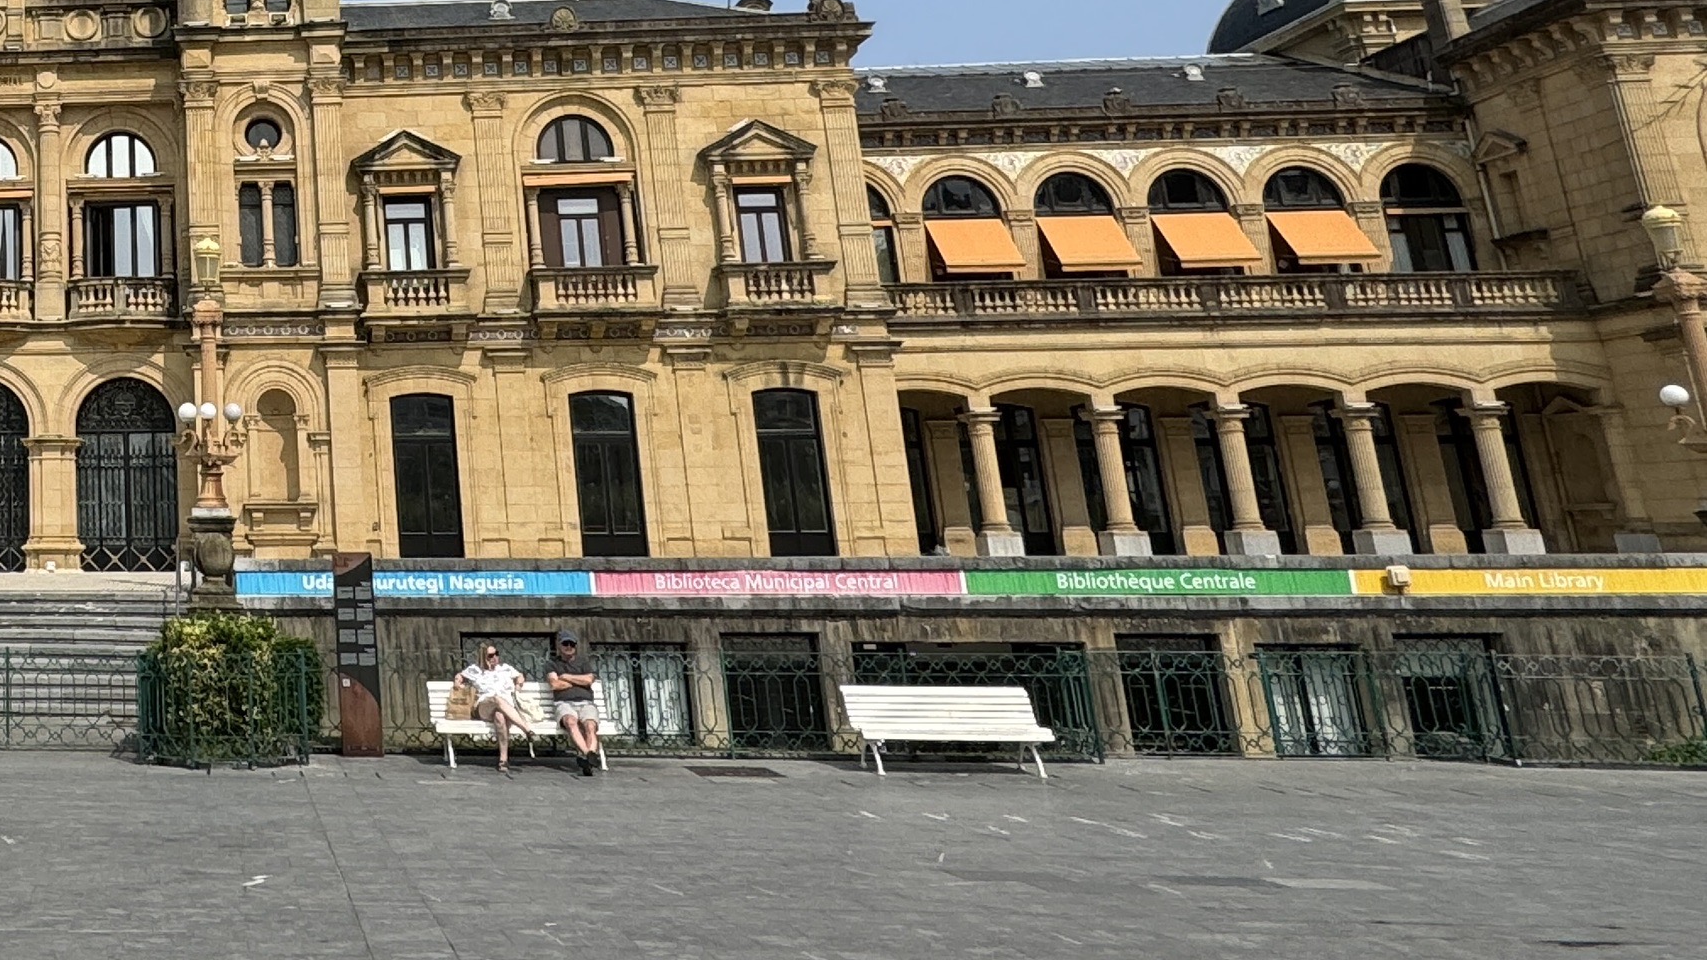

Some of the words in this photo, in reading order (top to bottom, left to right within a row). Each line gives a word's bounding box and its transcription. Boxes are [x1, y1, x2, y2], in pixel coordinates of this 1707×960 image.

[302, 574, 334, 591] Uda
[373, 575, 444, 594] urutegi
[449, 574, 524, 594] Nagusia
[655, 573, 740, 590] Biblioteca
[745, 574, 830, 592] Municipal
[835, 573, 898, 589] Central
[1056, 572, 1175, 592] Bibliothèque
[1179, 572, 1256, 589] Centrale
[1484, 572, 1534, 589] Main
[1538, 571, 1604, 593] Library
